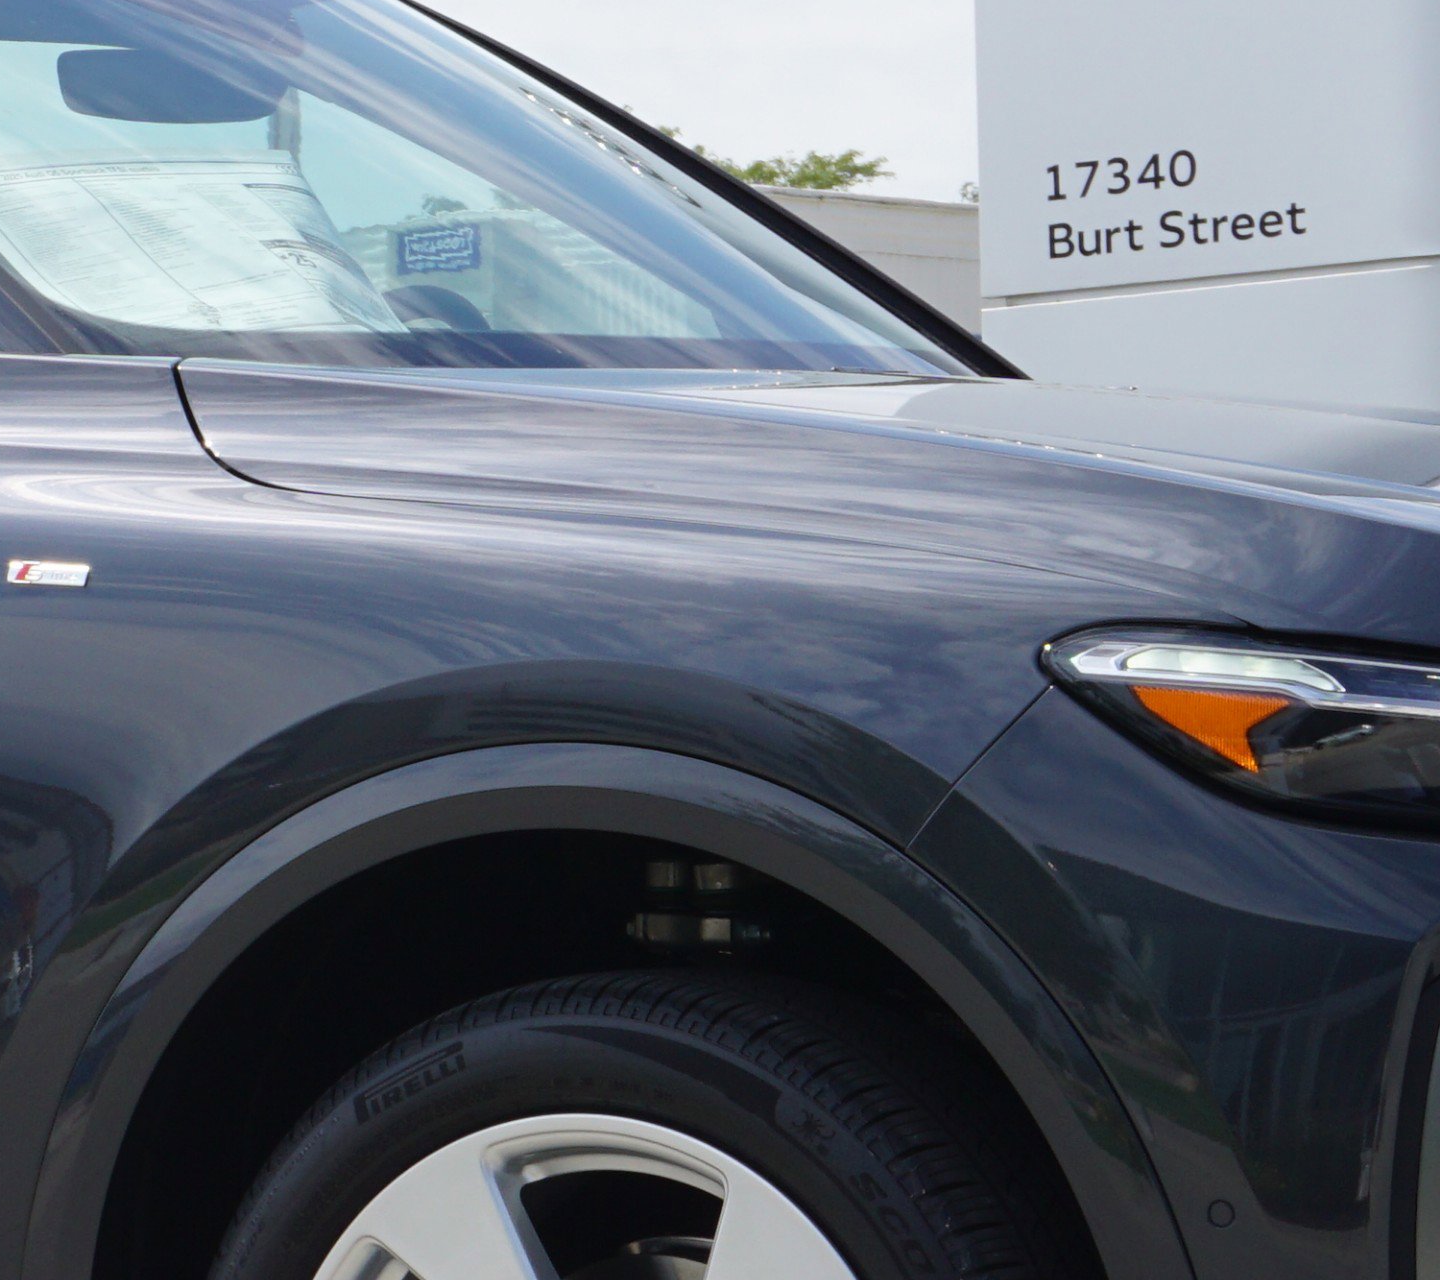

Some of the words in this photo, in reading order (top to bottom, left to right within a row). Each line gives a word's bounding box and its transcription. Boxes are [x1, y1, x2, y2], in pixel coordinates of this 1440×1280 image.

[1045, 149, 1197, 201] 17340
[1049, 219, 1143, 259] Burt
[1160, 202, 1307, 248] Street
[352, 1040, 467, 1126] PIRELLI
